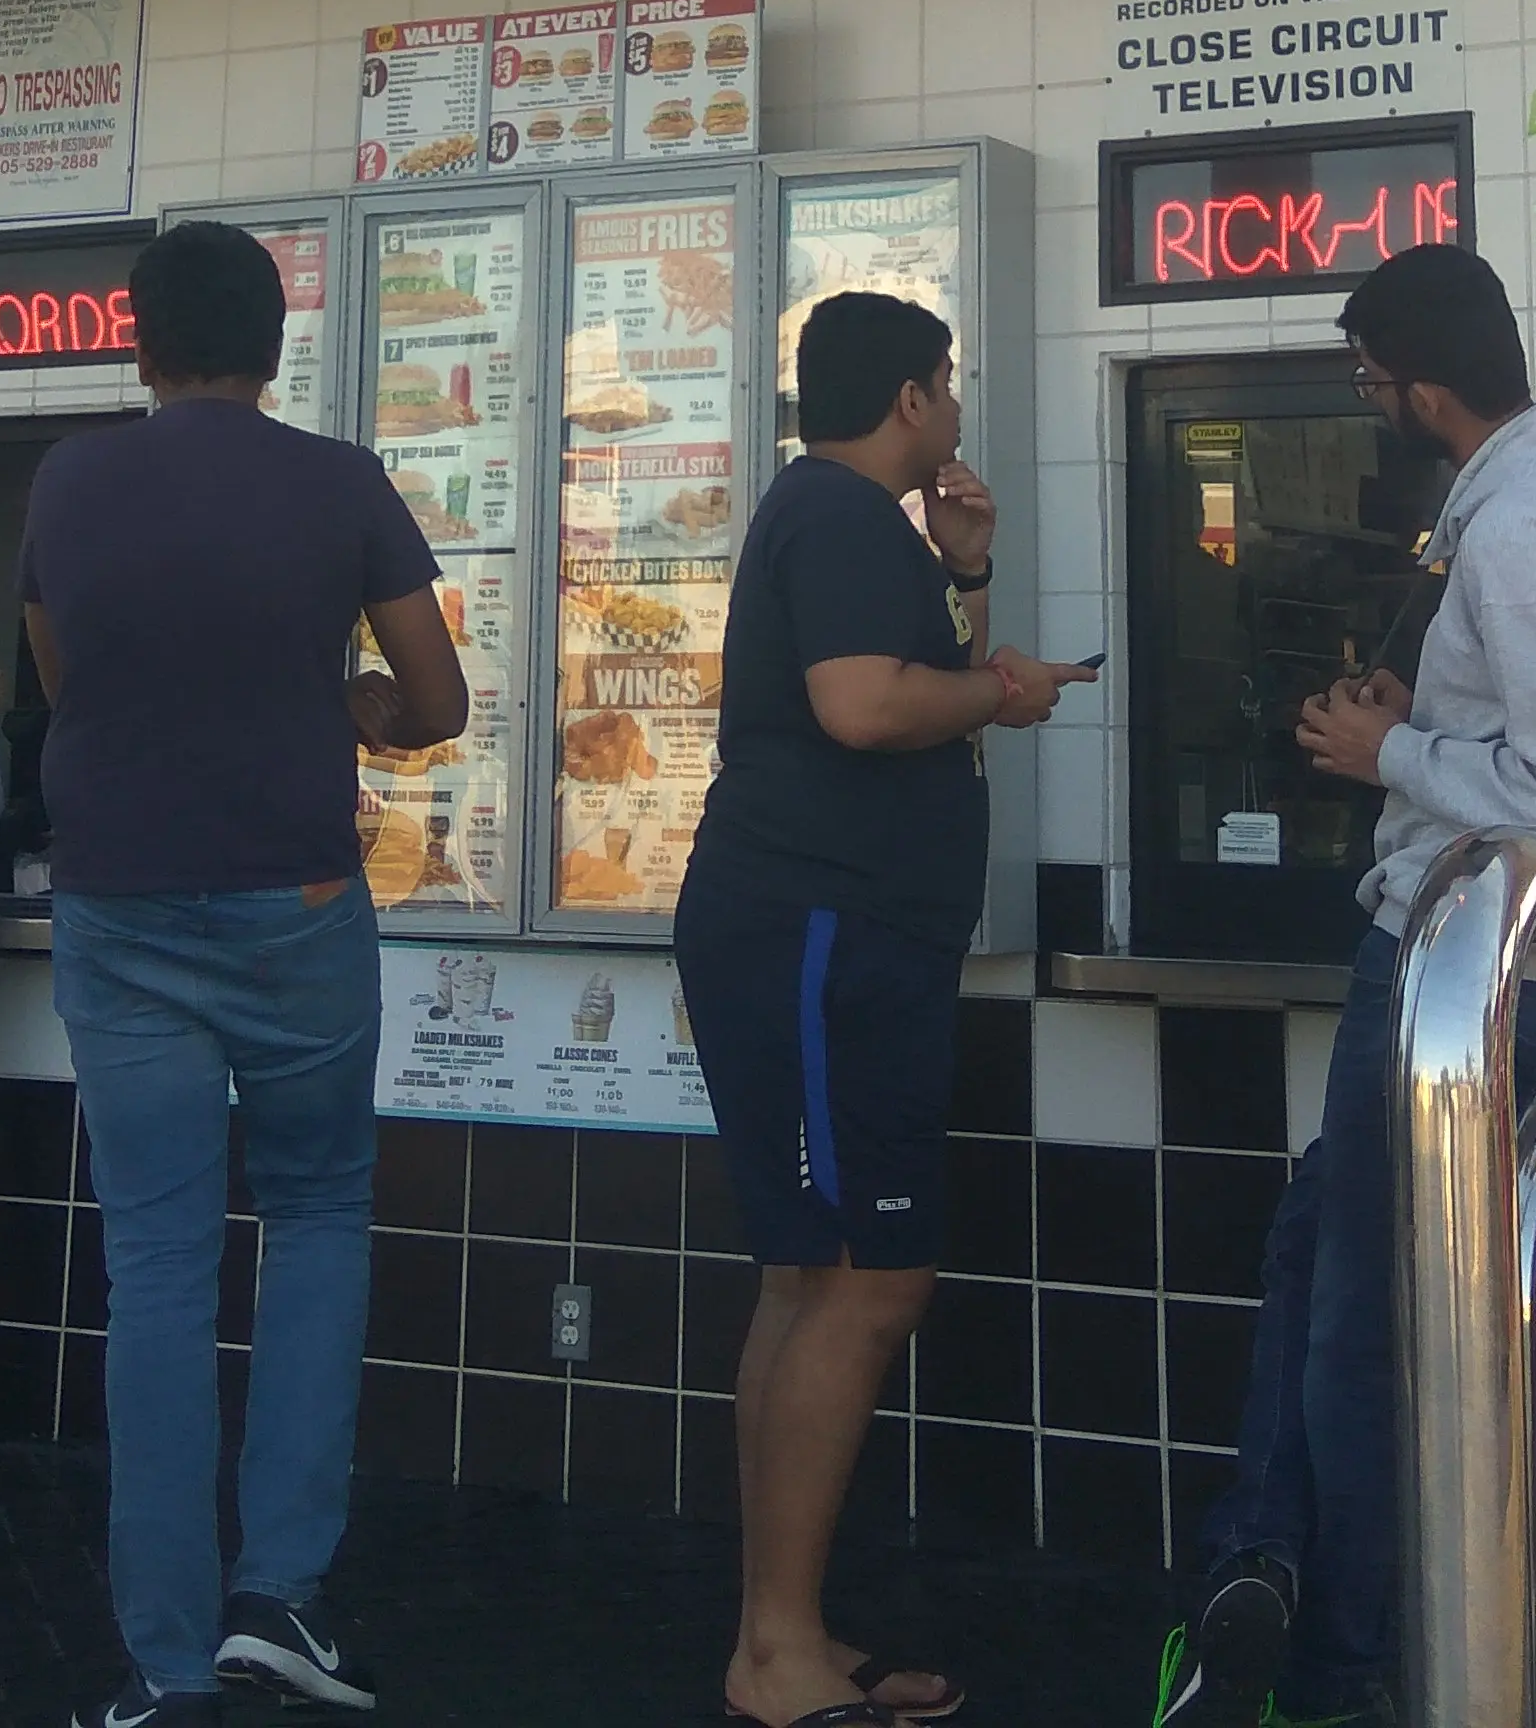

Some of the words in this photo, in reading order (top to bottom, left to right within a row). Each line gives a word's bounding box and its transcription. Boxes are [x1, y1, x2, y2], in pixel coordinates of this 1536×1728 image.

[501, 18, 531, 38] AT
[535, 7, 614, 34] EVERY
[403, 23, 478, 46] VALUE
[1117, 28, 1252, 70] CLOSE
[1271, 9, 1448, 56] CIRCUIT
[14, 62, 122, 112] TRESPASSING
[1152, 62, 1413, 114] TELEVISION
[31, 122, 65, 136] AFTER
[68, 118, 116, 133] WARNING
[22, 139, 59, 156] DRIVE-IN
[61, 134, 114, 152] RESTAURANT
[793, 193, 952, 232] MILKSHAKES
[580, 218, 638, 239] FAMOUS
[640, 210, 728, 252] FRIES
[580, 237, 638, 255] SEASONED
[689, 454, 726, 475] STIX
[644, 559, 690, 580] BITES
[692, 558, 724, 579] BOX
[594, 667, 701, 705] WINGS
[414, 1031, 446, 1046] LOADED
[448, 1033, 504, 1048] MILKSHAKES
[554, 1047, 589, 1061] CLASSIC
[590, 1049, 618, 1063] CONES
[666, 1051, 695, 1065] WAFFLE
[570, 1065, 606, 1073] CHOCOLATE
[547, 1087, 574, 1098] $1.00
